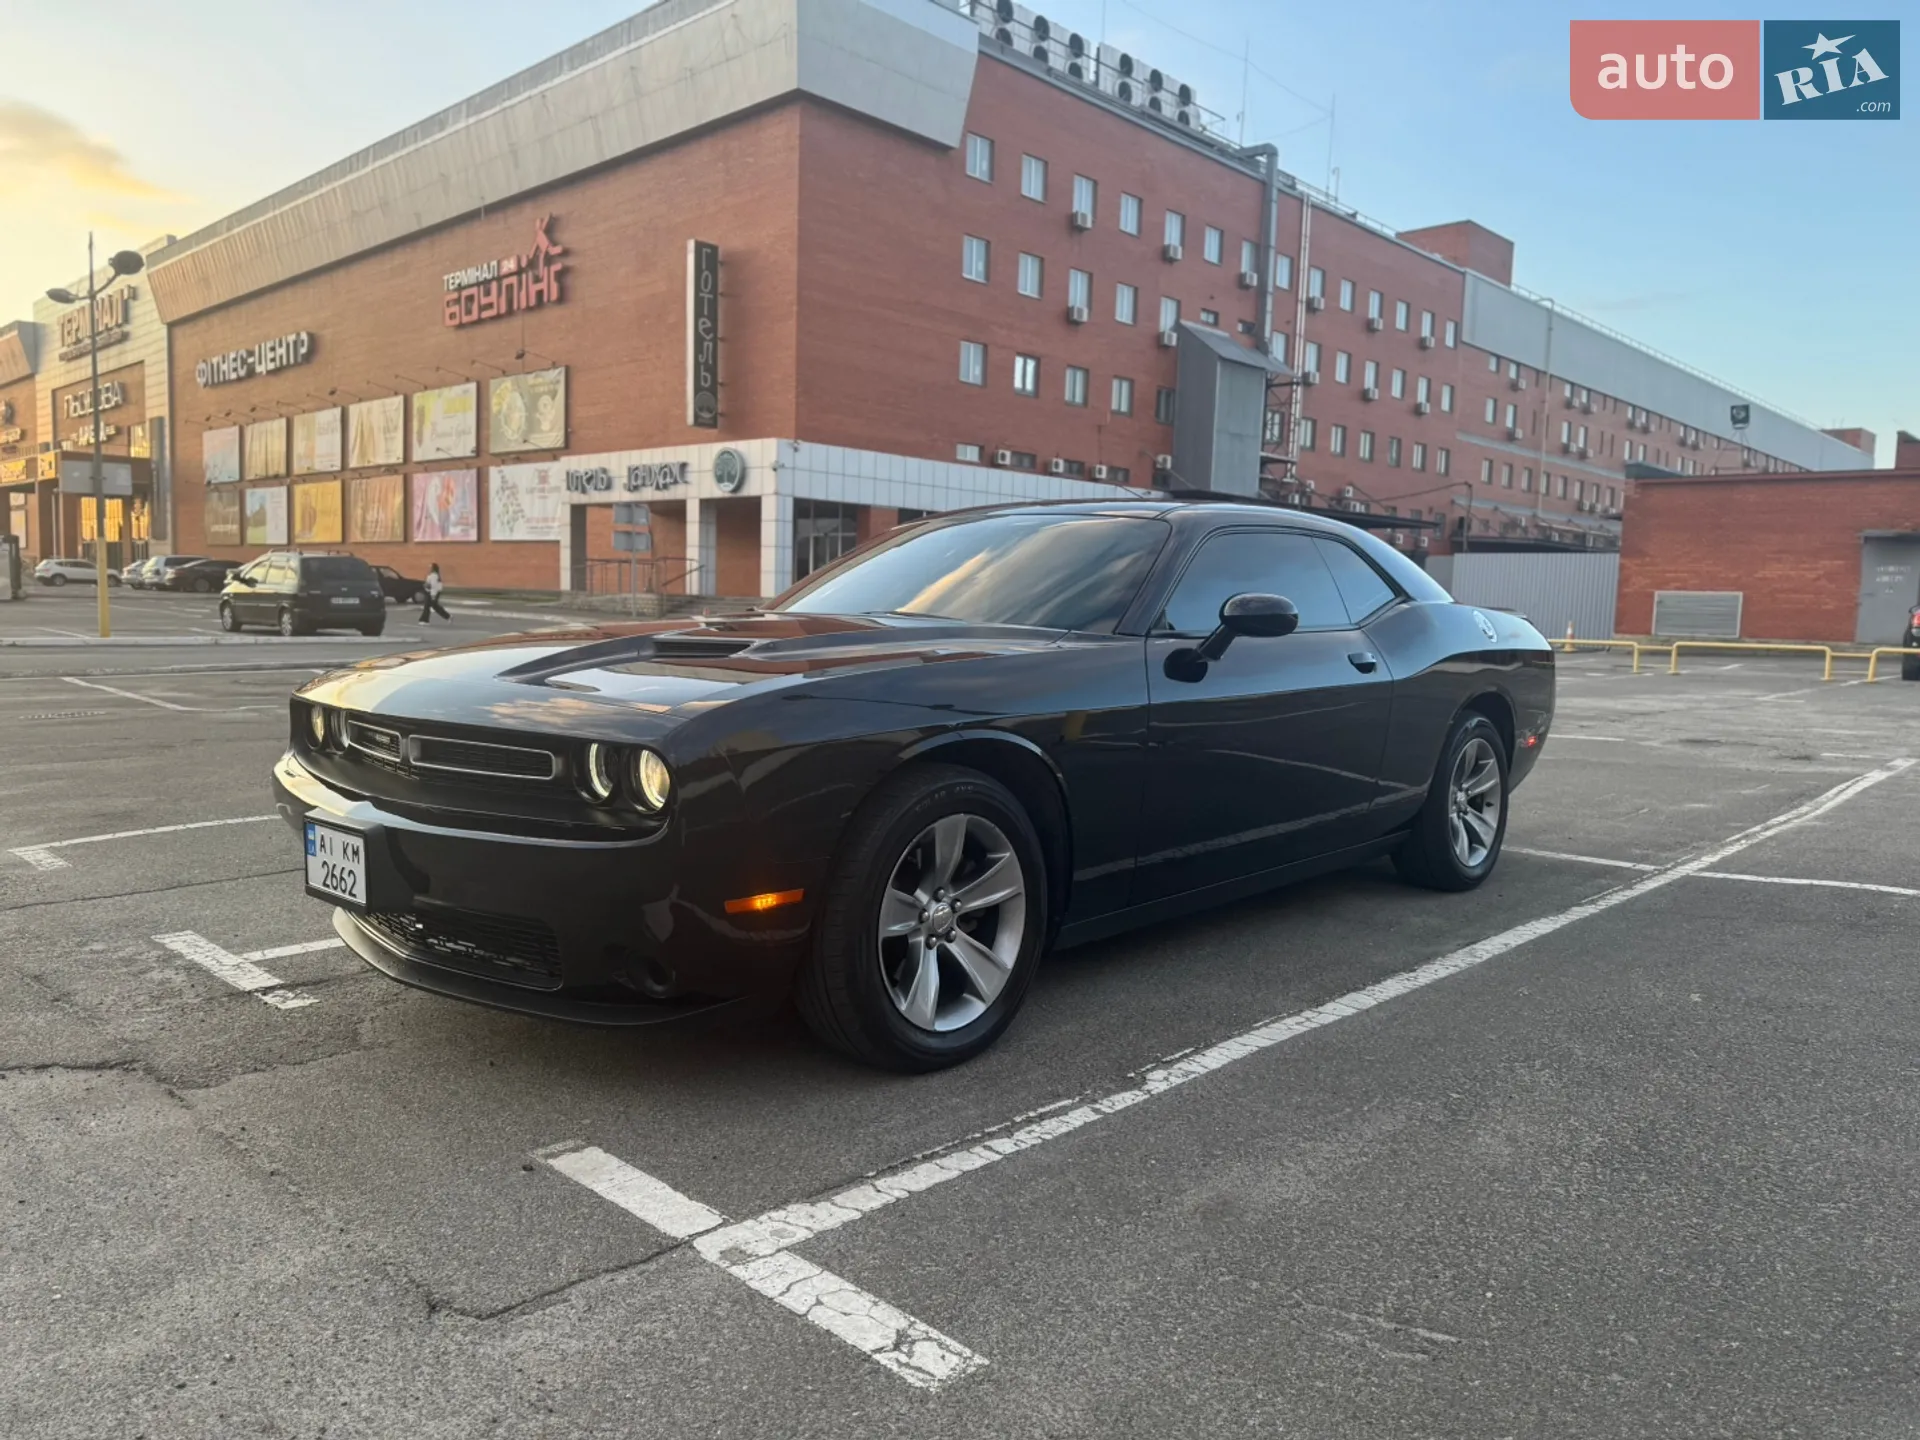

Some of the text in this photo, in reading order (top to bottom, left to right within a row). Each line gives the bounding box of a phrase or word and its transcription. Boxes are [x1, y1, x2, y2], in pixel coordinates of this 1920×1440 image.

[442, 259, 499, 291] ТЕРМІНАЛ
[57, 289, 125, 349] ТЕРМНАЛ
[196, 331, 309, 387] ФІТНЕС-ЦЕНТР
[319, 833, 334, 857] AI
[342, 840, 361, 865] KM
[321, 860, 358, 899] 2662
